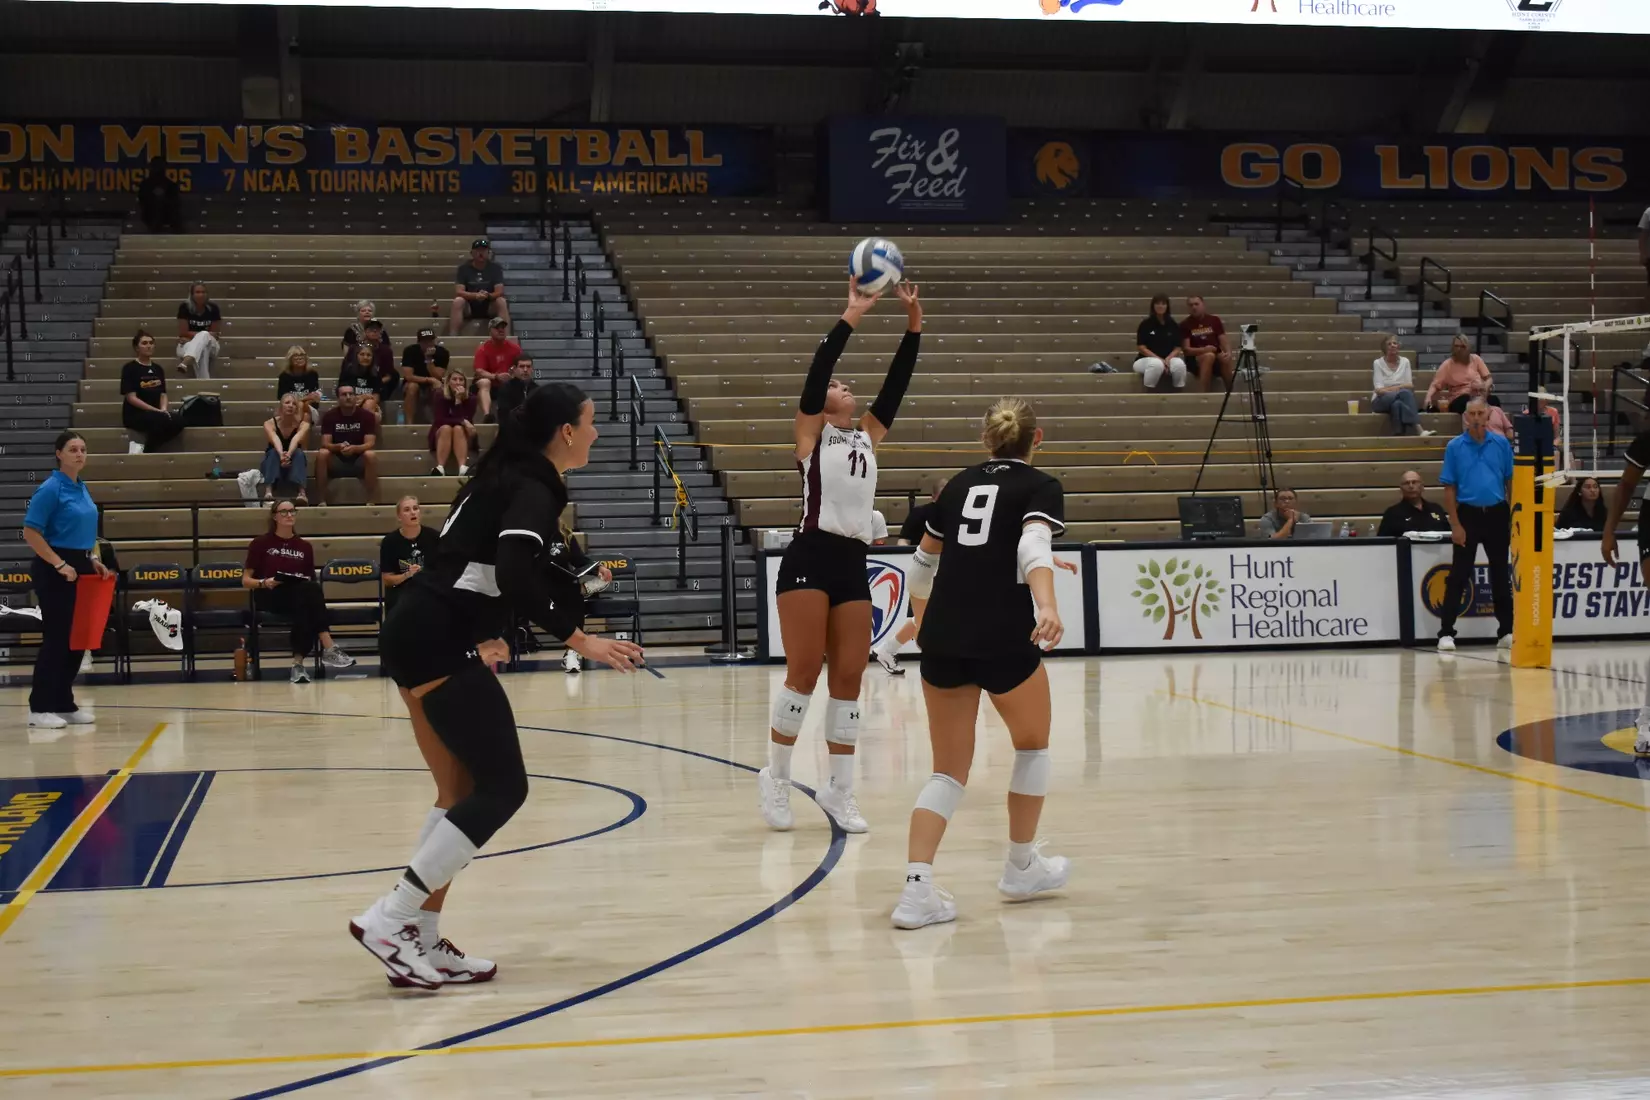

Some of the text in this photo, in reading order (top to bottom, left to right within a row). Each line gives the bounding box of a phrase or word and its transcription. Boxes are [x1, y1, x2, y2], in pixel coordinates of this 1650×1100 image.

[1299, 0, 1395, 16] Healthcare
[100, 124, 307, 164] MEN'S
[334, 126, 723, 167] BASKETBALL
[869, 127, 960, 175] Fix &
[1220, 142, 1628, 192] GO LIONS
[222, 169, 237, 192] 7
[243, 169, 301, 193] NCAA
[308, 169, 461, 194] TOURNAMENTS
[512, 170, 537, 194] 30
[547, 171, 708, 195] ALL-AMERICANS
[884, 163, 968, 204] Feed
[848, 449, 867, 478] 11
[957, 484, 999, 546] 9
[0, 573, 32, 583] LION
[135, 570, 180, 580] LIONS
[199, 568, 243, 579] LIONS
[330, 565, 373, 576] LIONS
[1230, 554, 1294, 579] Hunt
[1553, 562, 1645, 589] BEST PL
[1231, 579, 1338, 617] Regional
[1553, 590, 1650, 618] TO STAY!
[1232, 610, 1368, 639] Healthcare
